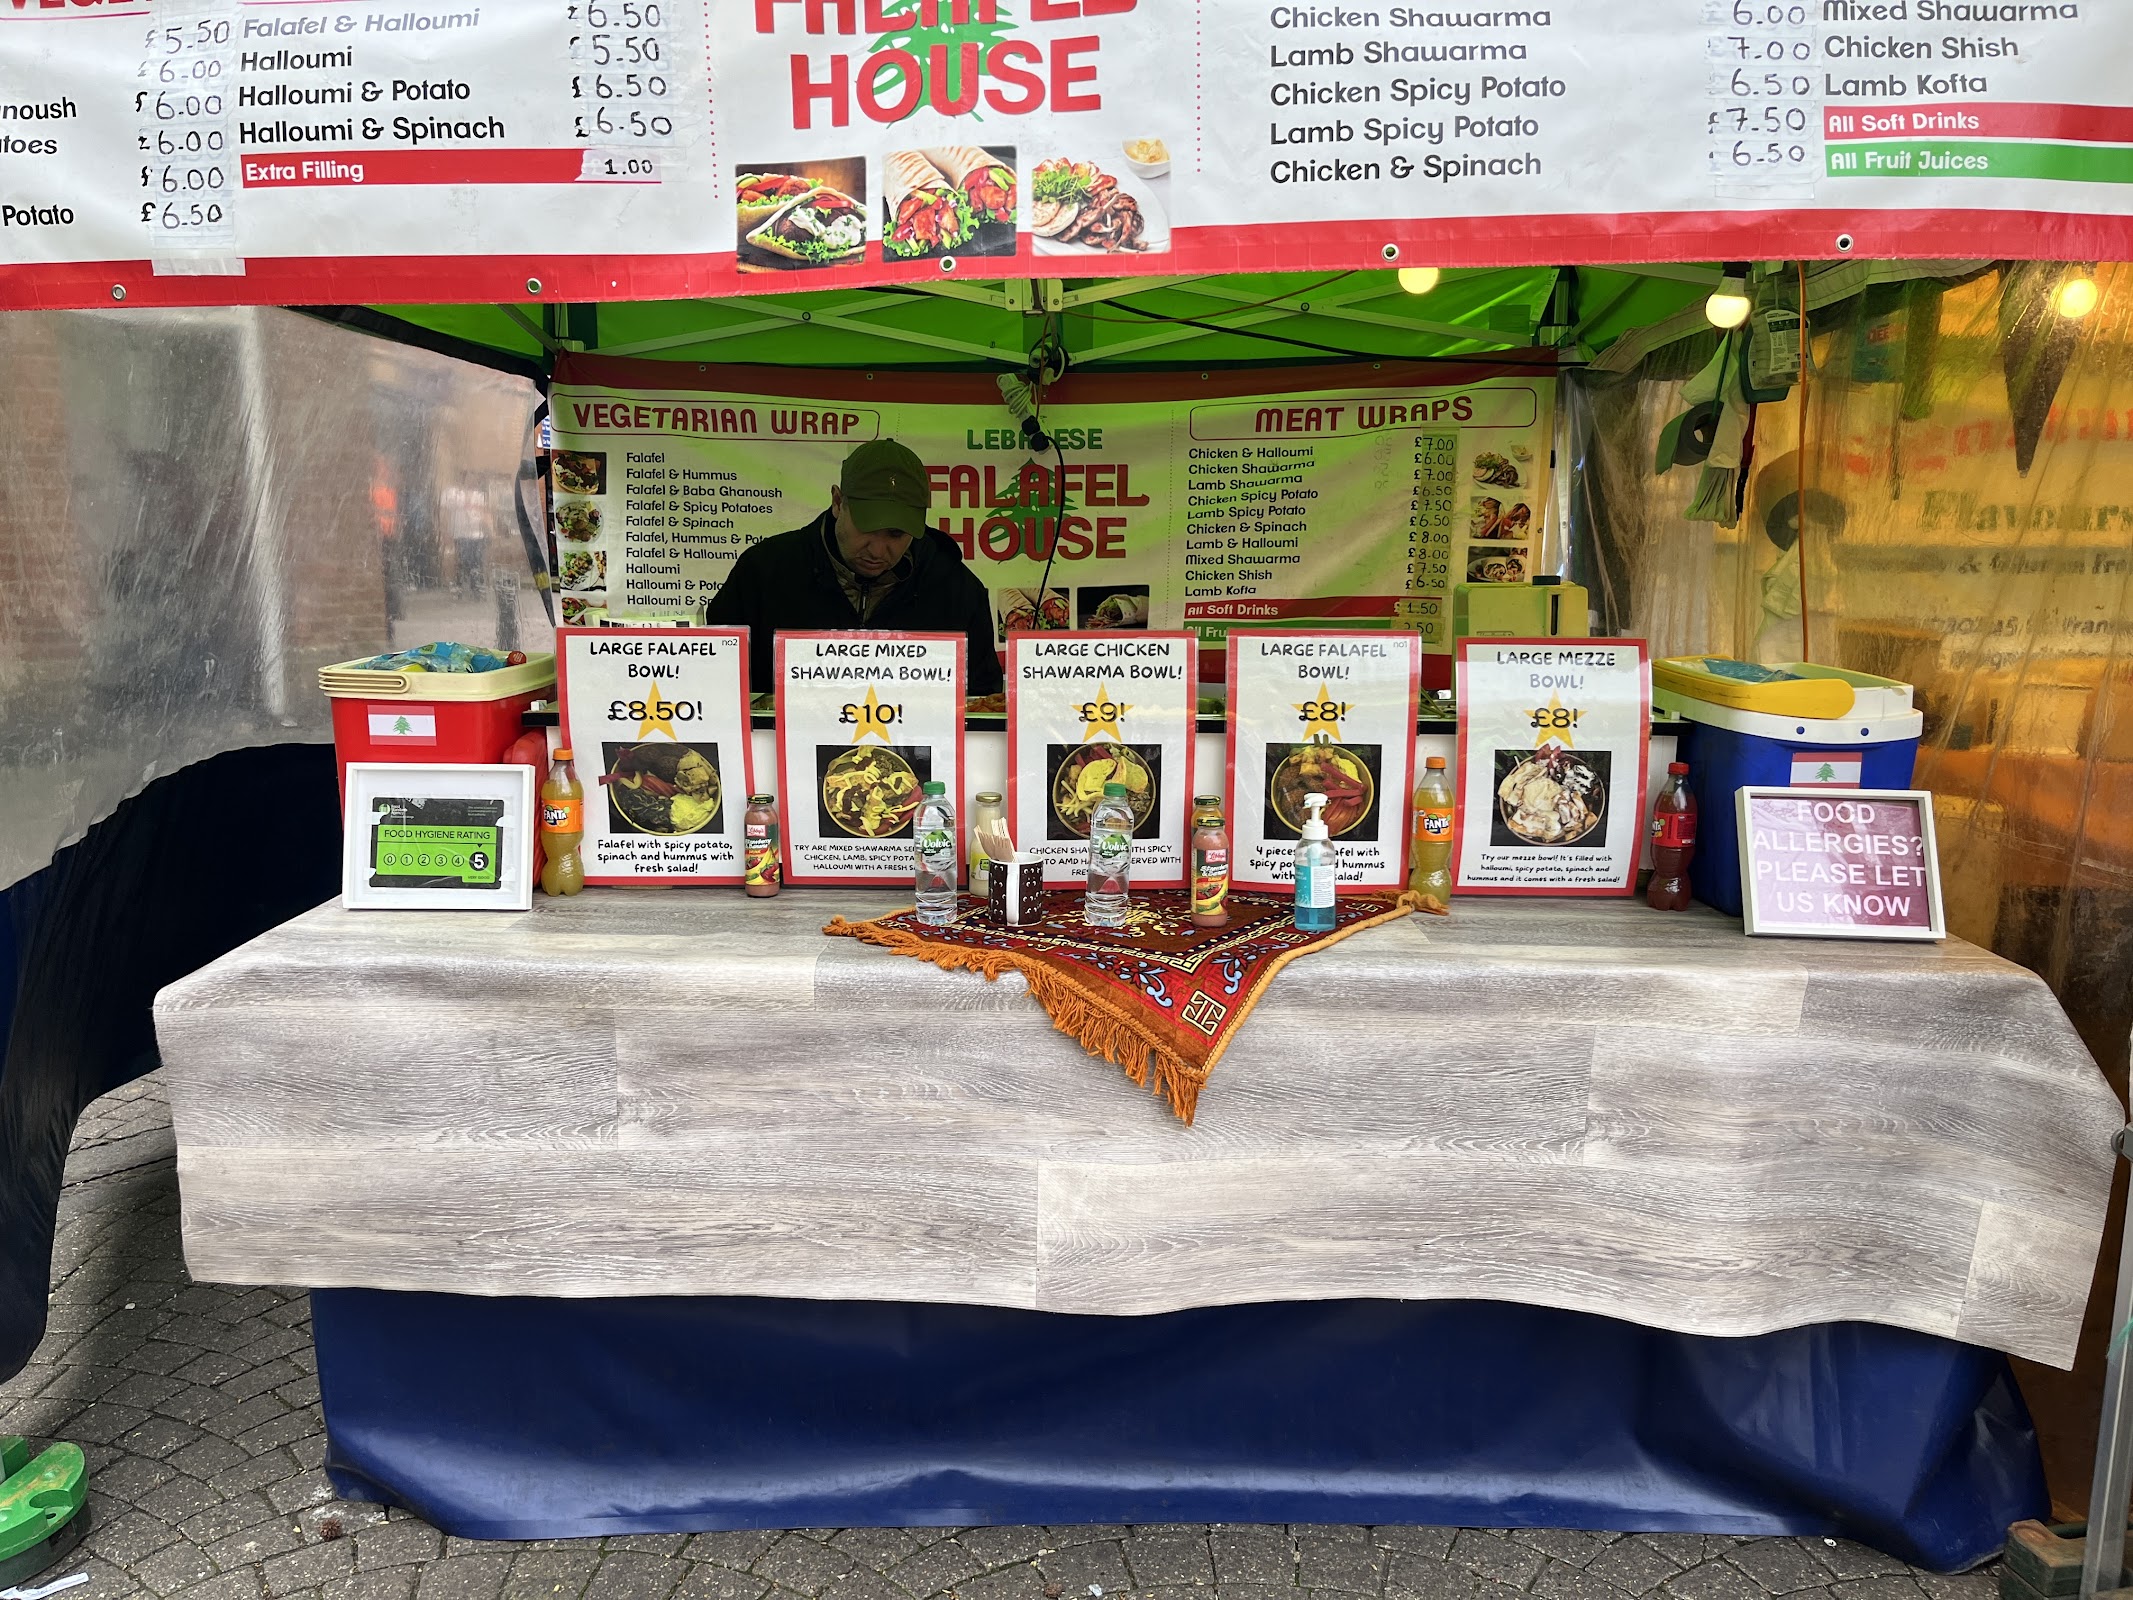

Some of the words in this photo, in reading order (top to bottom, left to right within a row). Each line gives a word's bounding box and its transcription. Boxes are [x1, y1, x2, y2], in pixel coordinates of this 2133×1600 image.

[1270, 6, 1380, 29] Chicken
[1389, 7, 1551, 28] Shawarma
[1823, 0, 1907, 21] Mixed
[1917, 2, 2078, 21] Shawarma
[243, 16, 327, 38] Falafel
[334, 15, 357, 33] &
[364, 8, 480, 32] Halloumi
[1270, 43, 1354, 67] Lamb
[1363, 40, 1527, 64] Shawarma
[1824, 35, 1932, 59] Chicken
[1941, 36, 2019, 59] Shish
[240, 46, 353, 72] Halloumi
[789, 34, 1101, 130] HOUSE
[1825, 73, 1907, 97] Lamb
[1917, 73, 1987, 95] Kofta
[238, 79, 352, 107] Halloumi
[360, 81, 383, 101] &
[392, 79, 470, 102] Potato
[1270, 81, 1380, 106] Chicken
[1390, 76, 1471, 107] Spicy
[1481, 75, 1566, 99] Potato
[1829, 113, 1854, 133] All
[1861, 113, 1905, 133] Soft
[1912, 111, 1980, 131] Drinks
[240, 118, 353, 145] Halloumi
[361, 118, 384, 140] &
[393, 116, 505, 144] Spinach
[1270, 120, 1354, 145] Lamb
[1363, 117, 1444, 147] Spicy
[1454, 114, 1539, 139] Potato
[1270, 158, 1380, 184] Chicken
[1390, 155, 1415, 179] &
[1423, 153, 1542, 183] Spinach
[1831, 151, 1857, 169] All
[1865, 151, 1912, 169] Fruit
[1918, 151, 1989, 171] Juices
[245, 163, 295, 181] Extra
[302, 161, 364, 183] Filling
[2, 204, 75, 227] Potato
[141, 202, 223, 229] £6.50
[572, 403, 758, 434] VEGETARIAN
[770, 410, 860, 436] WRAP
[1254, 407, 1345, 433] MEAT
[1356, 396, 1473, 430] WRAPS
[1414, 436, 1454, 451] £7.00
[626, 452, 665, 463] Falafel
[1188, 448, 1238, 459] Chicken
[1241, 447, 1254, 458] &
[1257, 446, 1314, 458] Halloumi
[1414, 451, 1454, 466] £6.00
[626, 468, 665, 479] Falafel
[668, 468, 680, 480] &
[682, 469, 737, 481] Hummus
[1188, 464, 1238, 475] Chicken
[1241, 460, 1315, 474] Shawarma
[924, 463, 1151, 509] FALAFEL
[1188, 479, 1226, 491] Lamb
[1229, 474, 1303, 490] Shawarma
[626, 484, 665, 495] Falafel
[668, 485, 680, 496] &
[683, 485, 715, 496] Baba
[719, 486, 783, 499] Ghanoush
[1188, 495, 1237, 507] Chicken
[1240, 490, 1277, 503] Spicy
[1281, 488, 1318, 500] Potato
[626, 500, 665, 511] Falafel
[668, 500, 680, 511] &
[683, 501, 718, 515] Spicy
[721, 502, 773, 514] Potatoes
[1187, 508, 1225, 520] Lamb
[1228, 506, 1265, 520] Spicy
[1268, 505, 1306, 516] Potato
[626, 516, 665, 527] Falafel
[668, 516, 679, 527] &
[682, 517, 734, 530] Spinach
[1186, 523, 1236, 534] Chicken
[1239, 522, 1251, 532] &
[1254, 521, 1307, 534] Spinach
[1409, 513, 1450, 527] £6.50
[626, 532, 668, 544] Falafel,
[671, 533, 727, 544] Hummus
[730, 534, 742, 545] &
[938, 516, 1127, 562] HOUSE
[1186, 539, 1223, 550] Lamb
[1227, 538, 1238, 549] &
[1242, 536, 1298, 549] Halloumi
[1408, 531, 1449, 544] £8.00
[626, 547, 665, 558] Falafel
[669, 548, 680, 558] &
[683, 548, 738, 560] Halloumi
[1185, 554, 1224, 565] Mixed
[1227, 553, 1301, 565] Shawarma
[626, 563, 681, 574] Halloumi
[1185, 570, 1235, 581] Chicken
[1238, 569, 1273, 580] Shish
[1184, 586, 1222, 597] Lamb
[1226, 585, 1257, 596] Kofta
[1187, 606, 1203, 616] All
[1206, 604, 1234, 615] Soft
[1237, 604, 1279, 616] Drinks
[589, 641, 643, 656] LARGE
[648, 642, 717, 656] FALAFEL
[721, 638, 738, 647] no2
[815, 643, 870, 658] LARGE
[875, 643, 927, 658] MIXED
[1035, 643, 1089, 657] LARGE
[1093, 642, 1170, 657] CHICKEN
[1261, 642, 1314, 657] LARGE
[1318, 643, 1387, 658] FALAFEL
[1393, 641, 1408, 649] no1
[1496, 651, 1553, 665] LARGE
[1558, 651, 1615, 667] MEZZE
[628, 663, 680, 679] BOWL!
[790, 666, 893, 680] SHAWARMA
[899, 666, 952, 682] BOWL!
[1022, 665, 1124, 679] SHAWARMA
[1130, 665, 1182, 680] BOWL!
[1298, 665, 1350, 680] BOWL!
[1529, 673, 1584, 690] BOWL!
[607, 700, 703, 722] £8.50!
[838, 703, 903, 724] £10!
[1078, 702, 1126, 723] £9!
[1298, 701, 1347, 722] £8!
[1530, 707, 1579, 729] £8!
[543, 809, 568, 820] FANTA
[1797, 801, 1876, 825] FOOD
[384, 829, 413, 838] FOOD
[415, 830, 455, 839] HYGIENE
[457, 831, 491, 840] RATING
[598, 839, 635, 850] Falafel
[637, 839, 661, 850] with
[664, 840, 691, 852] spicy
[694, 840, 733, 852] potato,
[922, 838, 951, 848] Volvic
[1101, 840, 1129, 851] Volvic
[1753, 830, 1923, 857] ALLERGIES?
[473, 853, 485, 870] 5
[597, 851, 637, 864] spinach
[640, 851, 660, 861] and
[663, 851, 707, 861] hummus
[710, 851, 734, 861] with
[634, 863, 664, 873] fresh
[666, 863, 699, 874] salad!
[1756, 860, 1866, 885] PLEASE
[1875, 864, 1925, 887] LET
[1776, 892, 1814, 914] US
[1823, 894, 1911, 917] KNOW
